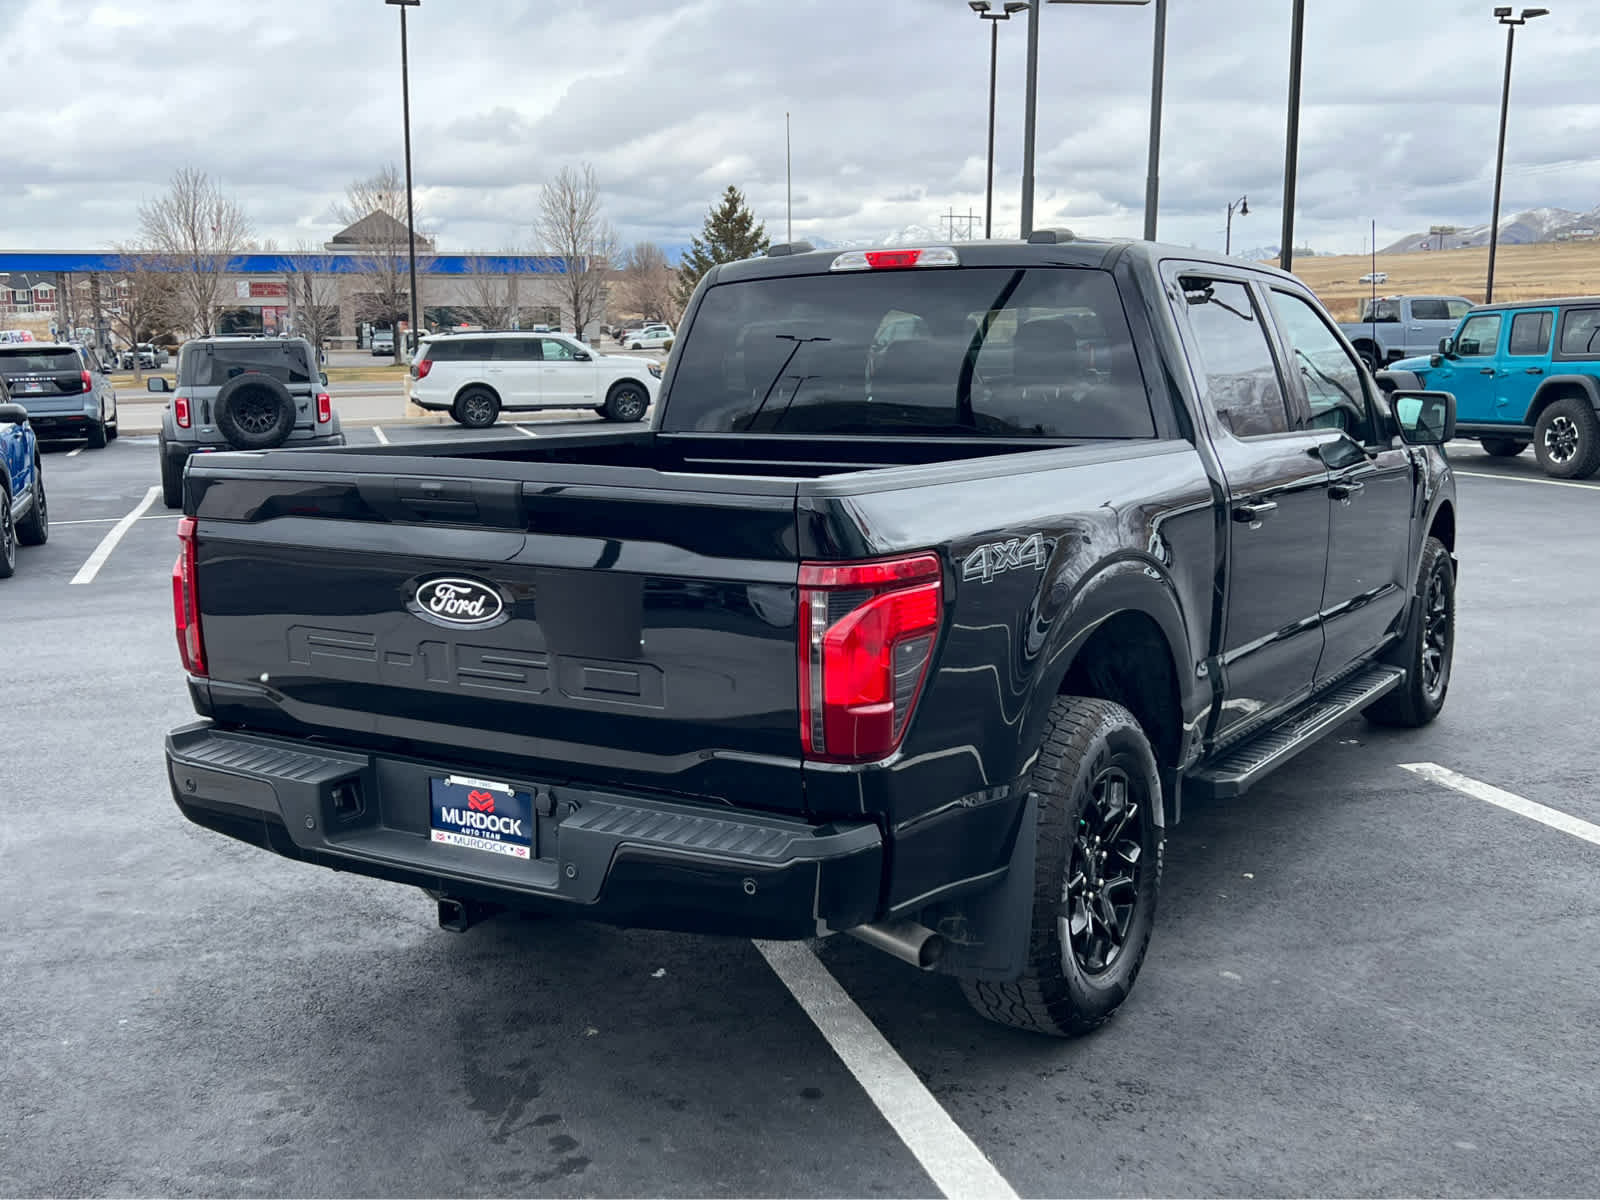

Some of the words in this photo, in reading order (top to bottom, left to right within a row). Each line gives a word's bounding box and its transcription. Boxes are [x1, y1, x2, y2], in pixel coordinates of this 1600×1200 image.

[430, 583, 487, 617] Ford
[287, 624, 667, 710] F-150
[441, 807, 522, 837] MURDOCK
[461, 828, 480, 837] AUTO
[482, 831, 501, 841] TEAM
[453, 837, 507, 855] MURDOCK
